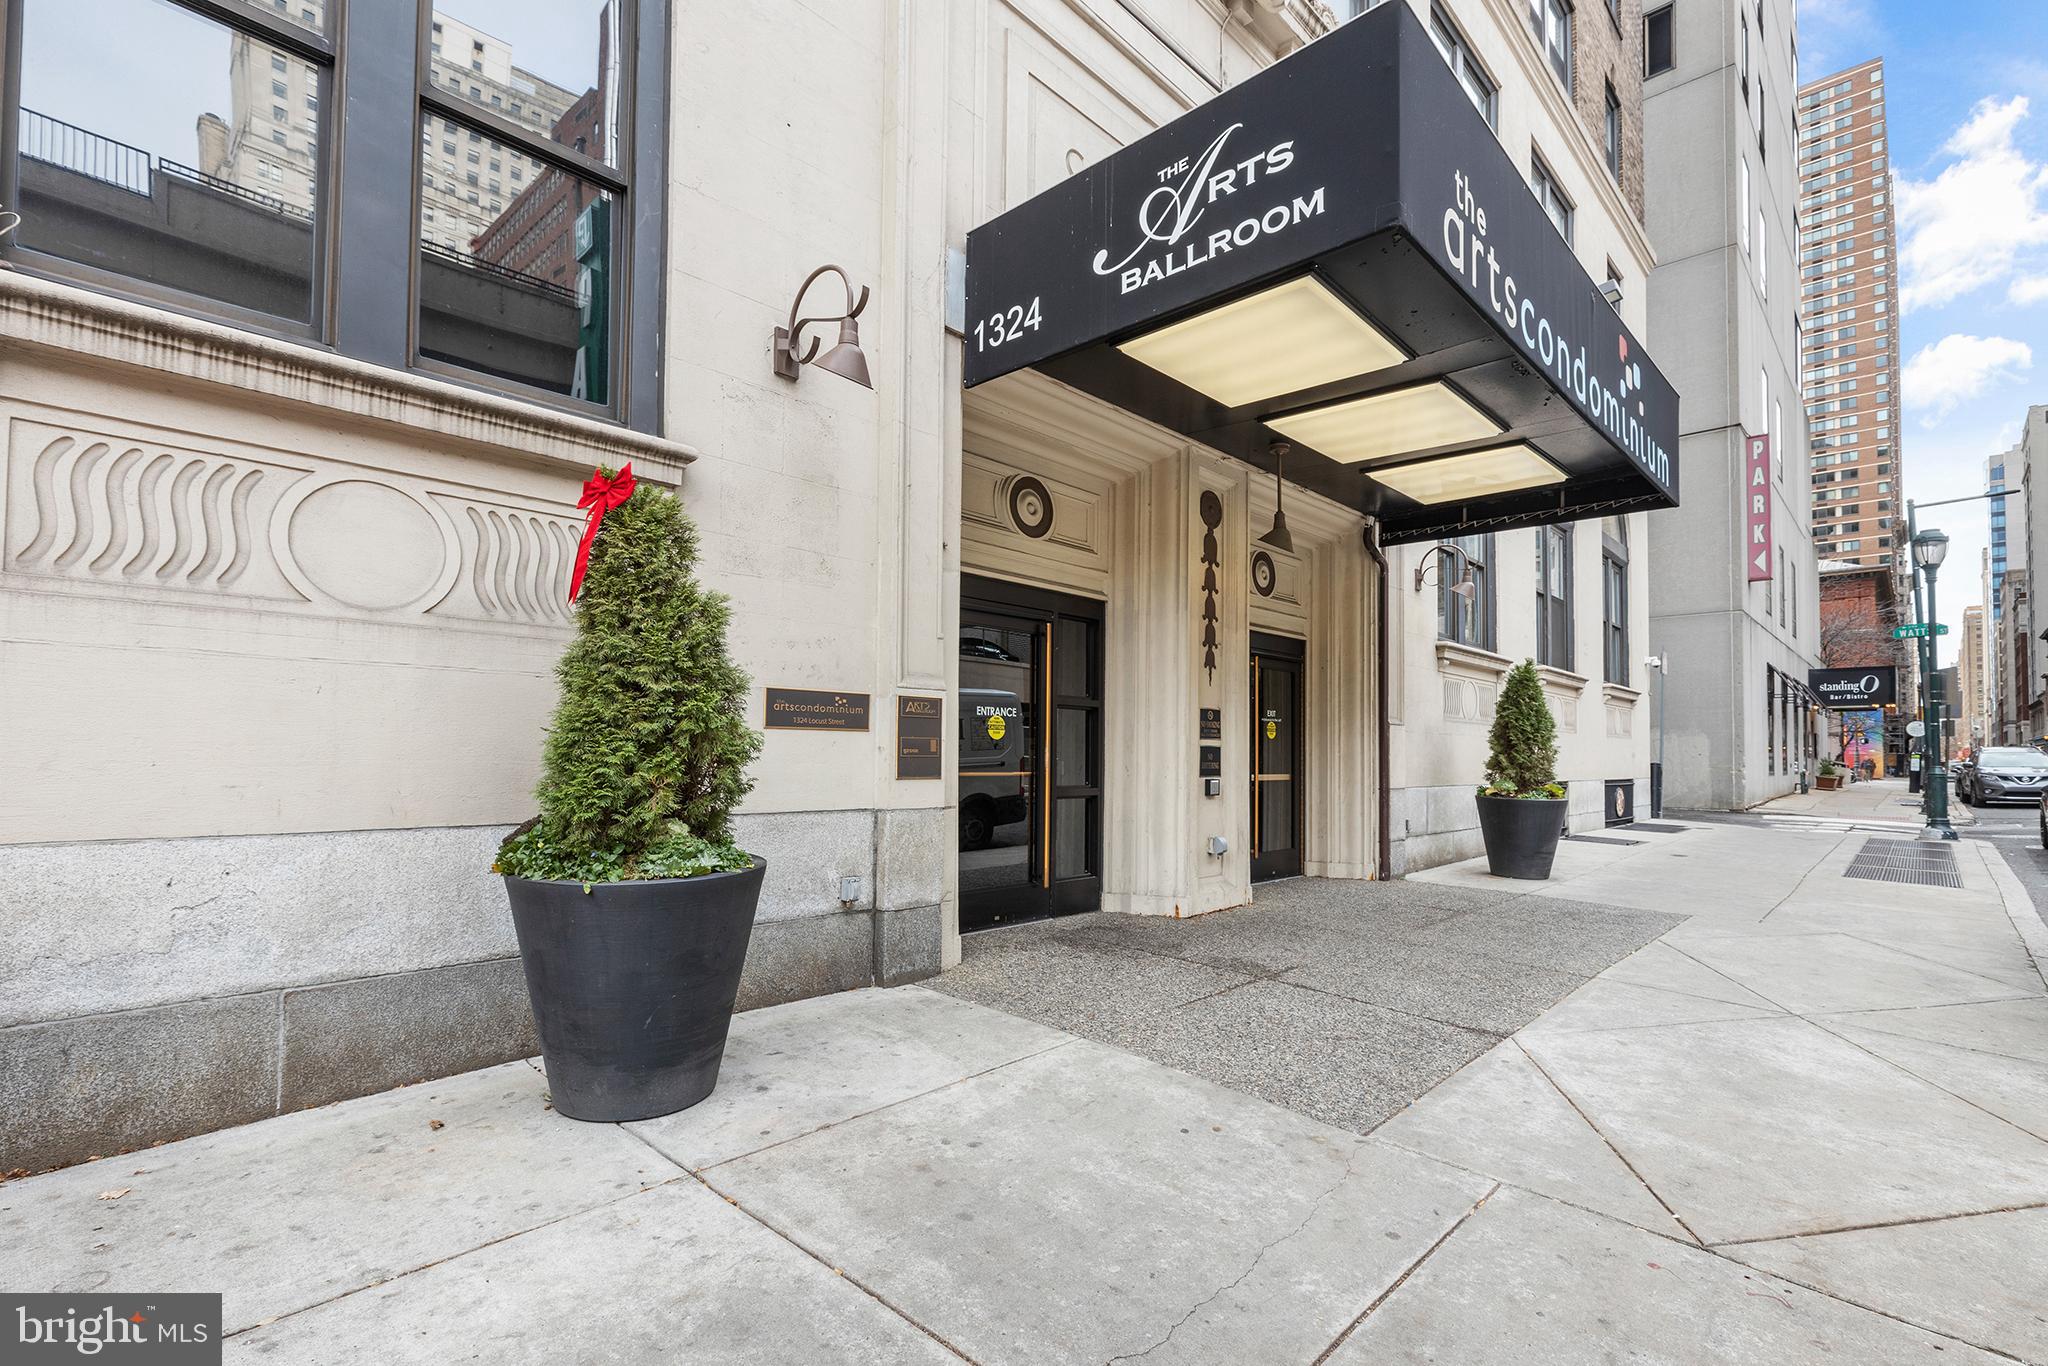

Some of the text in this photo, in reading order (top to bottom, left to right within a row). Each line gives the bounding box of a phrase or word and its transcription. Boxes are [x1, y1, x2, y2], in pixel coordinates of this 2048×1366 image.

[1092, 122, 1295, 275] ARTS
[1156, 156, 1190, 184] THE
[1454, 168, 1488, 234] the
[1119, 186, 1326, 295] BALLROOM
[973, 296, 1043, 354] 1324
[1442, 206, 1670, 488] artscondominium
[1752, 440, 1767, 544] PARK
[773, 702, 864, 715] artscondominium
[793, 716, 845, 726] 1324 Locust Street
[976, 706, 1017, 717] ENTRANCE
